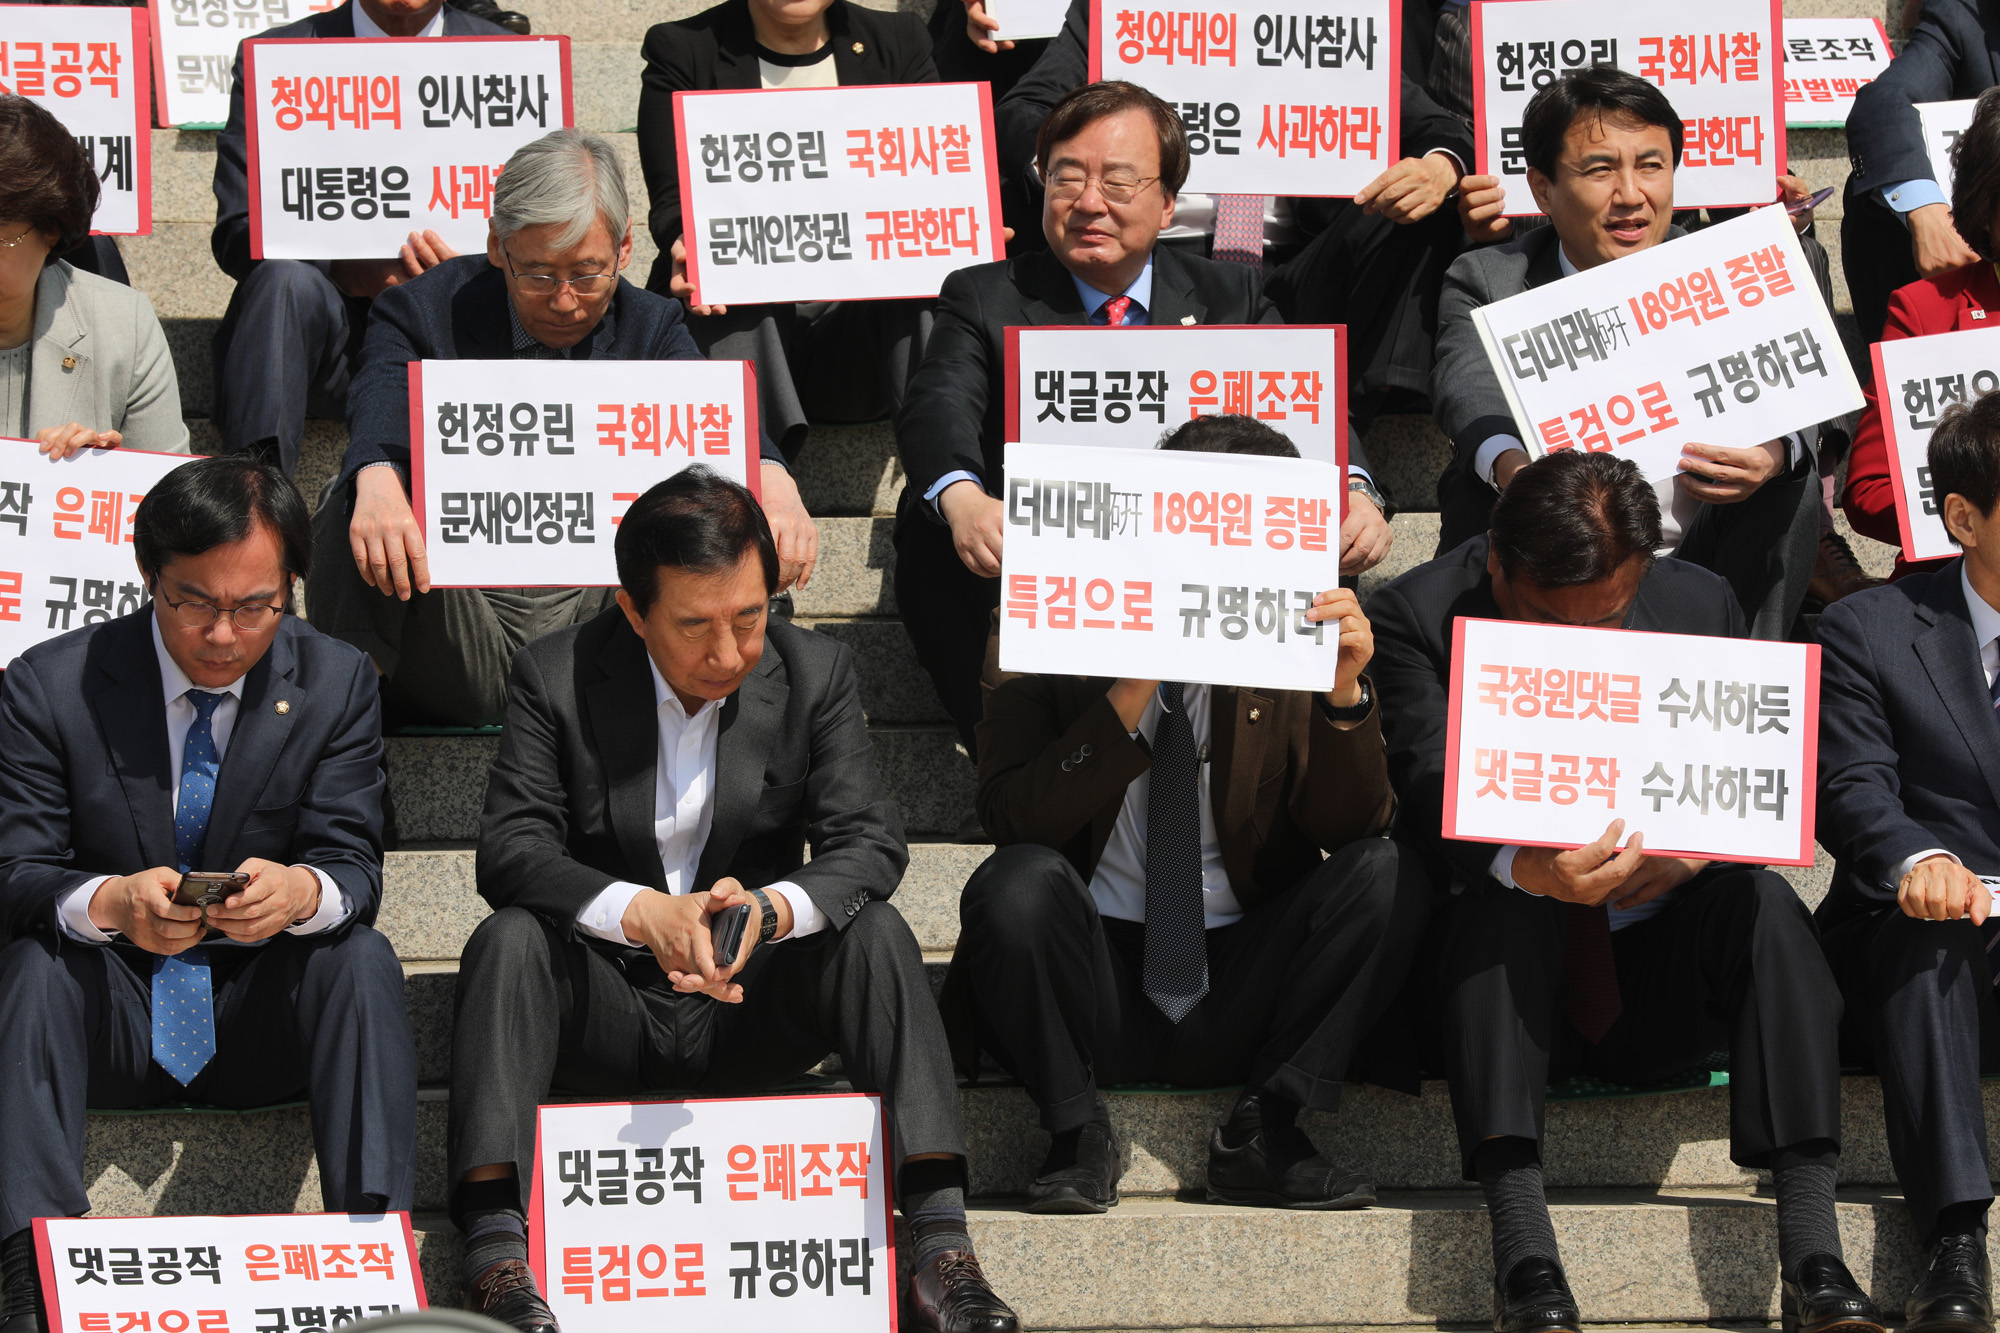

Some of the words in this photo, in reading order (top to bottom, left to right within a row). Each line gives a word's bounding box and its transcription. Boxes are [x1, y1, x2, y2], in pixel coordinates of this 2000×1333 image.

[1115, 10, 1236, 67] 청와대의
[1254, 14, 1377, 70] 인사참사
[1638, 32, 1761, 87] 국회사찰
[1783, 37, 1877, 63] 론조작
[271, 76, 401, 131] 청와대의
[418, 74, 549, 129] 인사참사
[700, 131, 828, 183] 헌정유린
[847, 125, 971, 177] 국회사찰
[1257, 104, 1381, 160] 사과하라
[1681, 115, 1765, 168] 탄한다
[281, 166, 411, 221] 대통령은
[428, 164, 506, 219] 사과
[709, 212, 852, 265] 문재인정권
[866, 206, 980, 260] 규탄한다
[1628, 266, 1730, 335] 18억원
[1724, 244, 1795, 307] 증발
[1035, 370, 1169, 424] 댓글공작
[1188, 369, 1323, 424] 은폐조작
[1686, 328, 1828, 418] 규명하라
[438, 402, 574, 456] 헌정유린
[596, 403, 732, 456] 국회사찰
[440, 492, 595, 545] 문재인정권
[1154, 491, 1251, 546] 18억원
[1265, 497, 1331, 551] 증발
[1007, 575, 1153, 631] 특검으로
[1480, 665, 1641, 723] 국정원댓글
[1659, 678, 1790, 734] 수사하듯
[1476, 750, 1620, 809] 댓글공작
[1642, 762, 1788, 821] 수사하라
[559, 1146, 704, 1207] 댓글공작
[727, 1141, 871, 1201] 은폐조작
[68, 1246, 221, 1285] 댓글공작
[245, 1243, 394, 1281] 은폐조작
[562, 1243, 706, 1304] 특검으로
[729, 1237, 874, 1299] 규명하라
